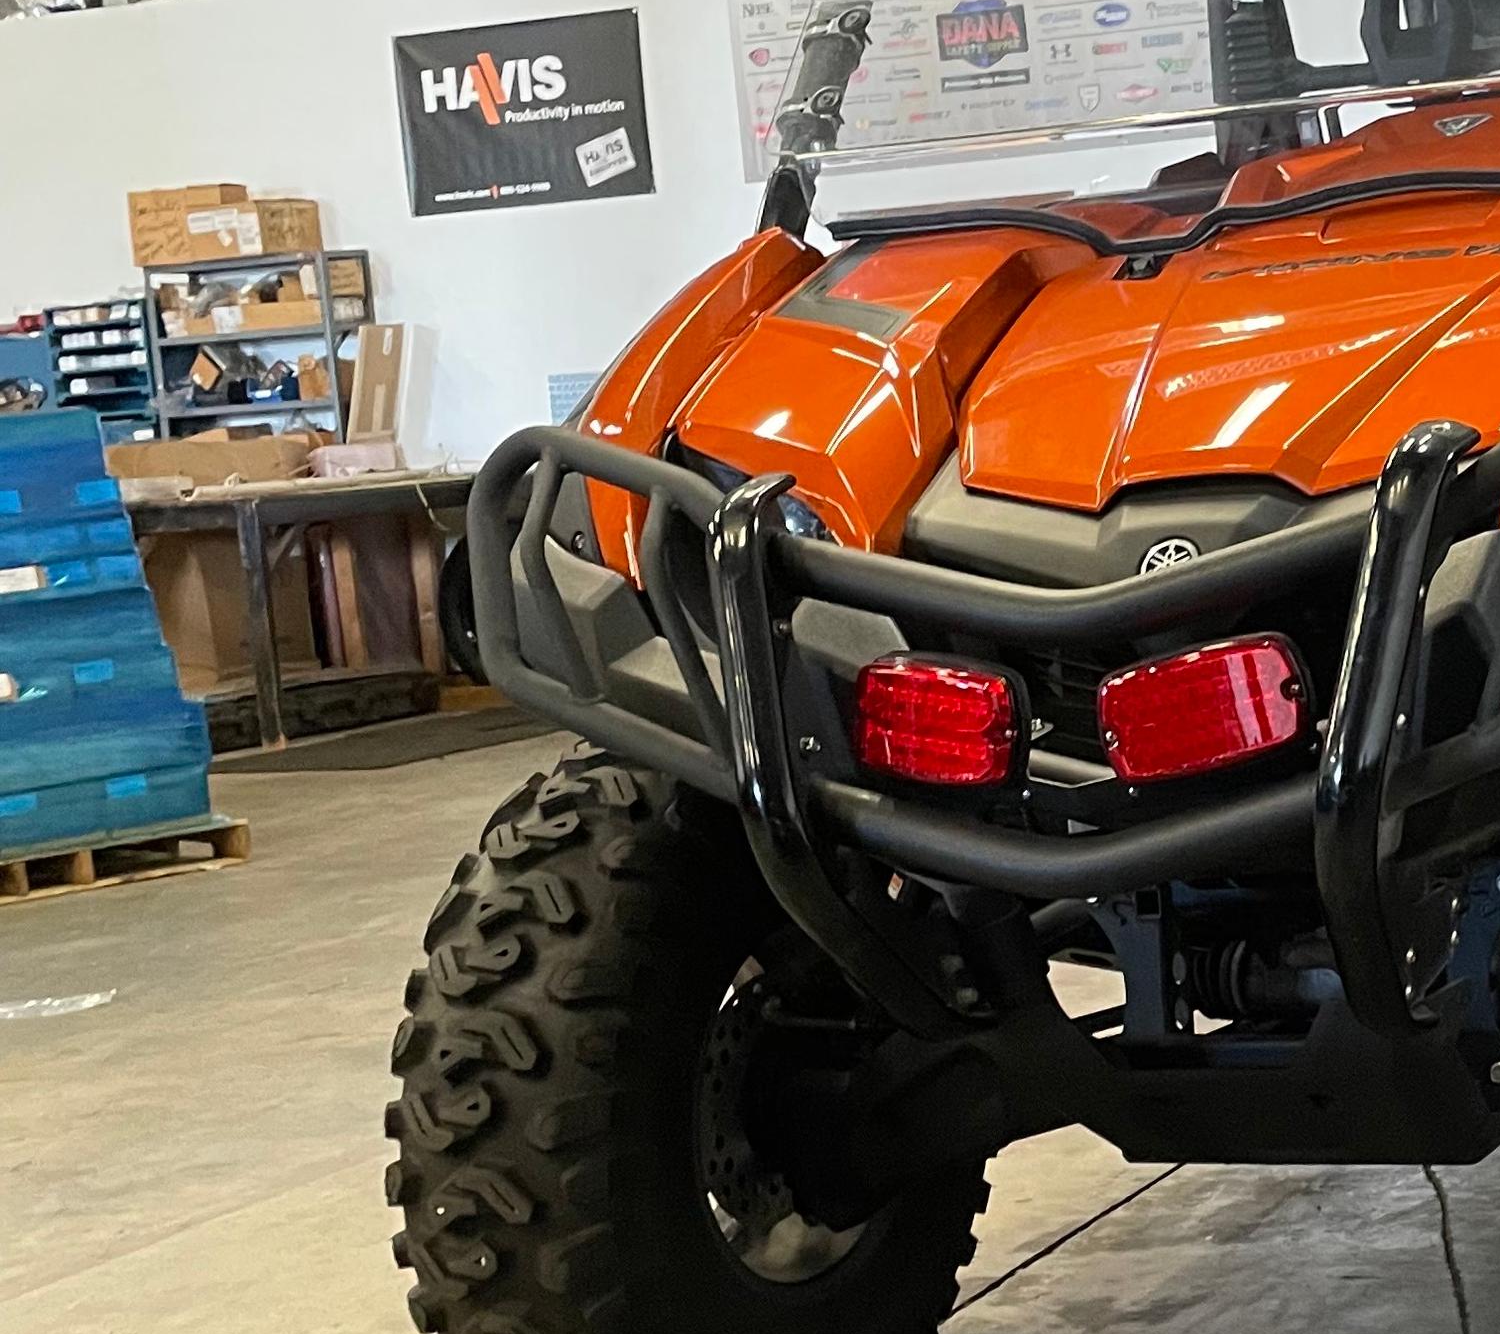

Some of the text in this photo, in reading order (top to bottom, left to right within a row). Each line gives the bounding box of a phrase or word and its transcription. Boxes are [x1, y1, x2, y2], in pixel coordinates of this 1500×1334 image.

[941, 10, 1021, 47] DANA
[420, 52, 567, 126] HAVIS
[504, 98, 625, 124] Productivity in motion
